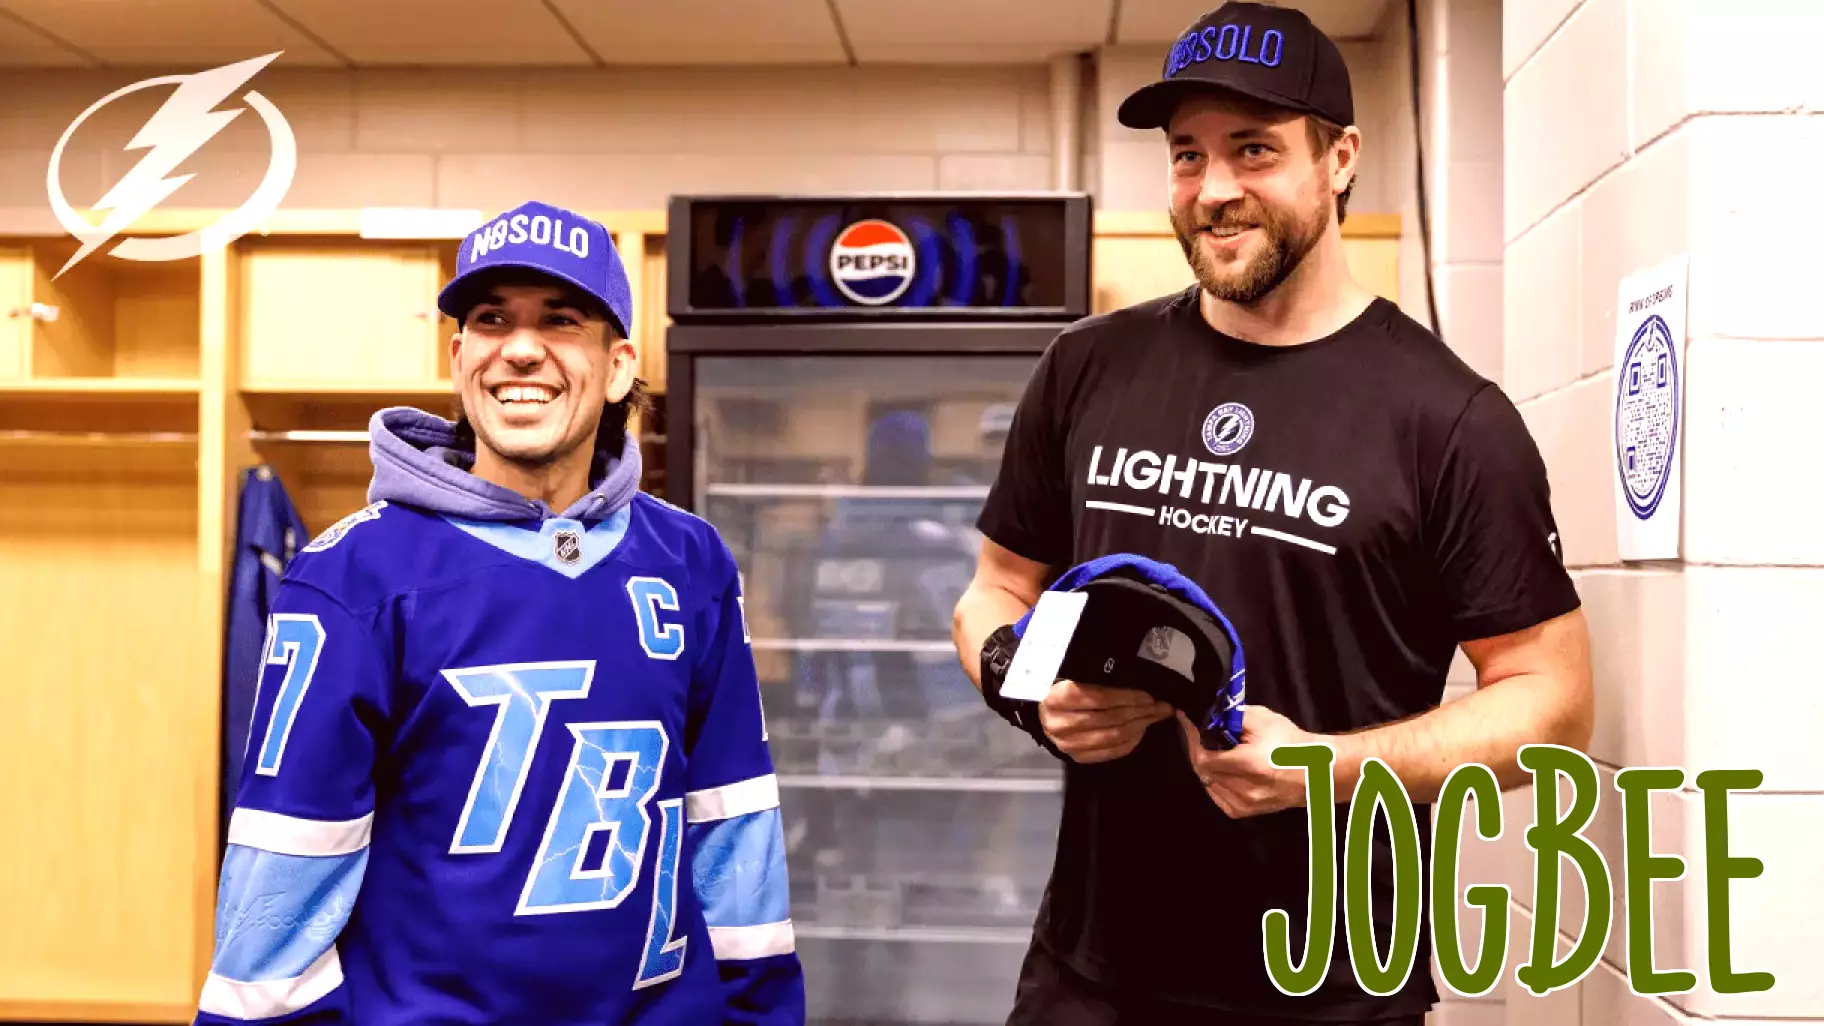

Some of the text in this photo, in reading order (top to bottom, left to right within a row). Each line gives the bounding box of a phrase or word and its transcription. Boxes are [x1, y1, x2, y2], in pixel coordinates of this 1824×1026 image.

[837, 254, 909, 272] PEPSI
[1087, 446, 1350, 527] LIGHTNING
[1159, 505, 1249, 538] HOCKEY
[626, 576, 685, 661] C
